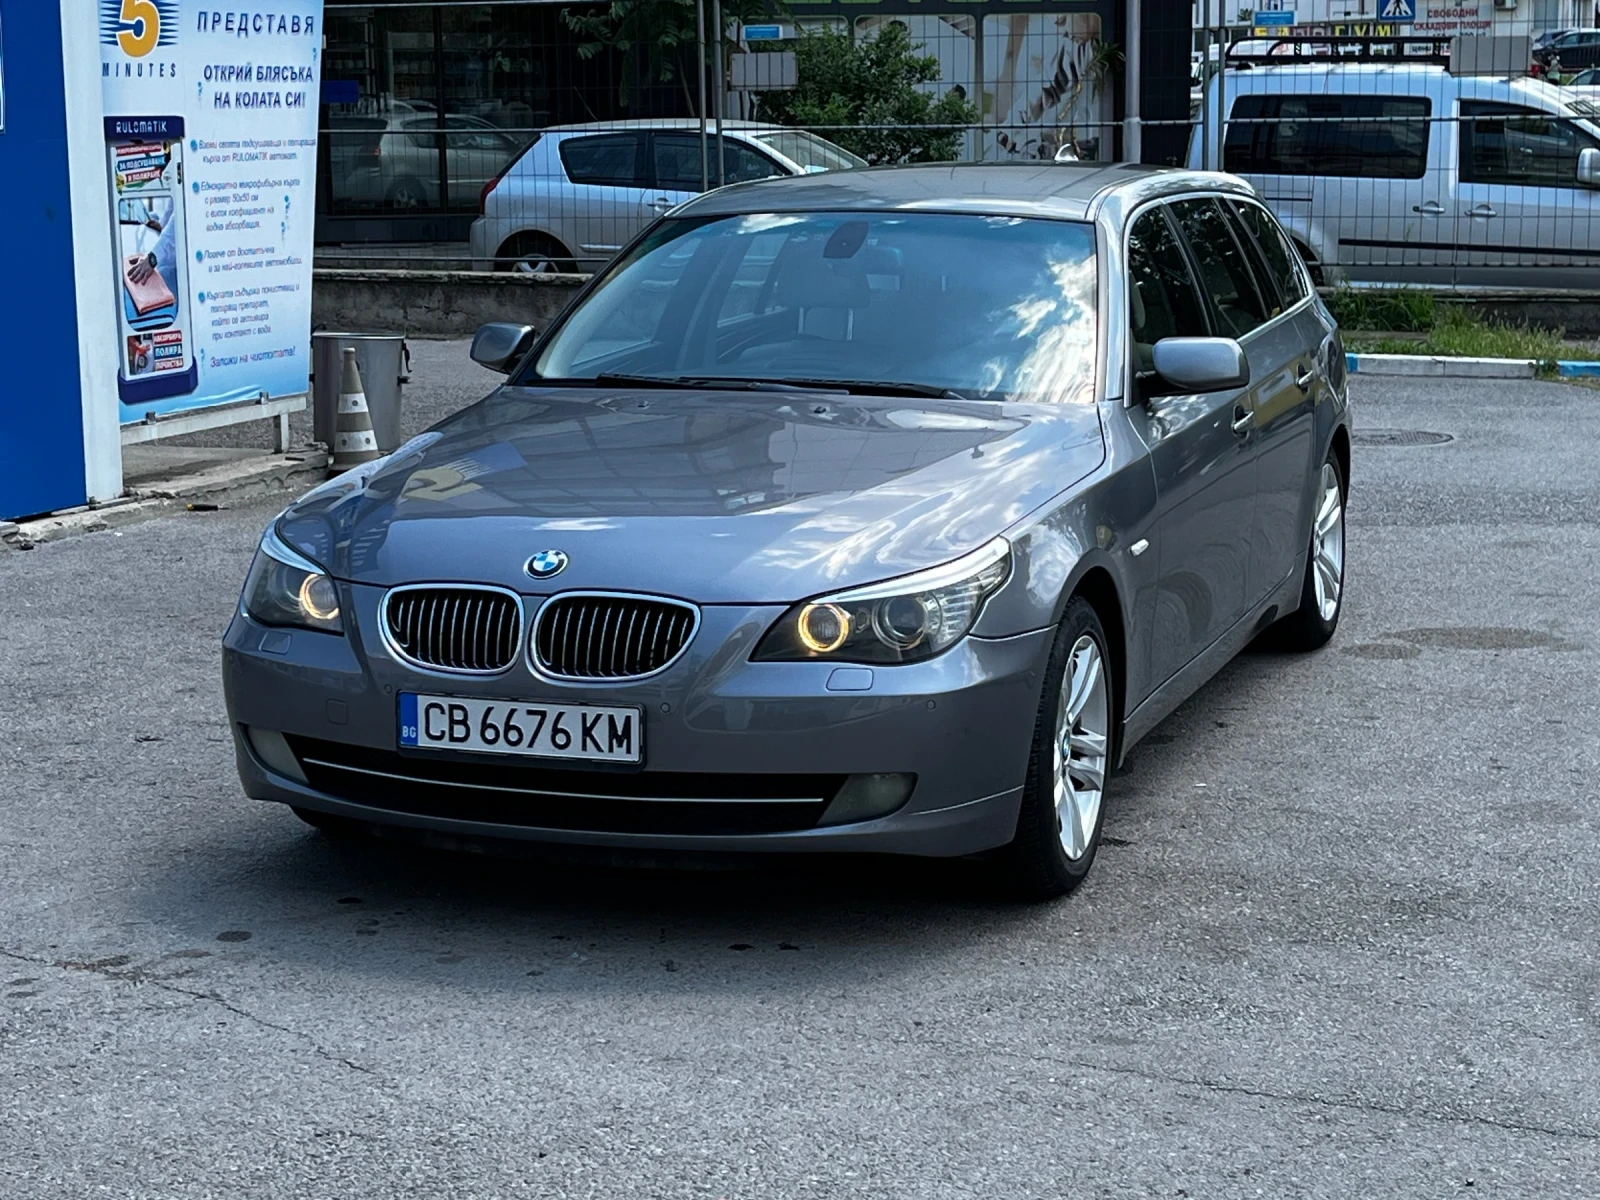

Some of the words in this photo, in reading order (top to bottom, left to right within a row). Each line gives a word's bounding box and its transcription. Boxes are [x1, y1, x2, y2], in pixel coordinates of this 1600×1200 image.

[197, 11, 315, 38] ПРЕДСТАВЯ
[101, 62, 177, 78] MINUTES
[203, 62, 252, 82] ОТКРИЙ
[256, 65, 314, 83] БЛЯСЪКА
[214, 92, 231, 109] НА
[235, 92, 281, 108] КОЛАТА
[285, 92, 306, 108] СИ!
[116, 121, 167, 133] RULOMATIK
[232, 152, 268, 161] RULOMATIK
[210, 353, 238, 368] Заложи
[240, 354, 249, 363] на
[402, 726, 417, 738] BG
